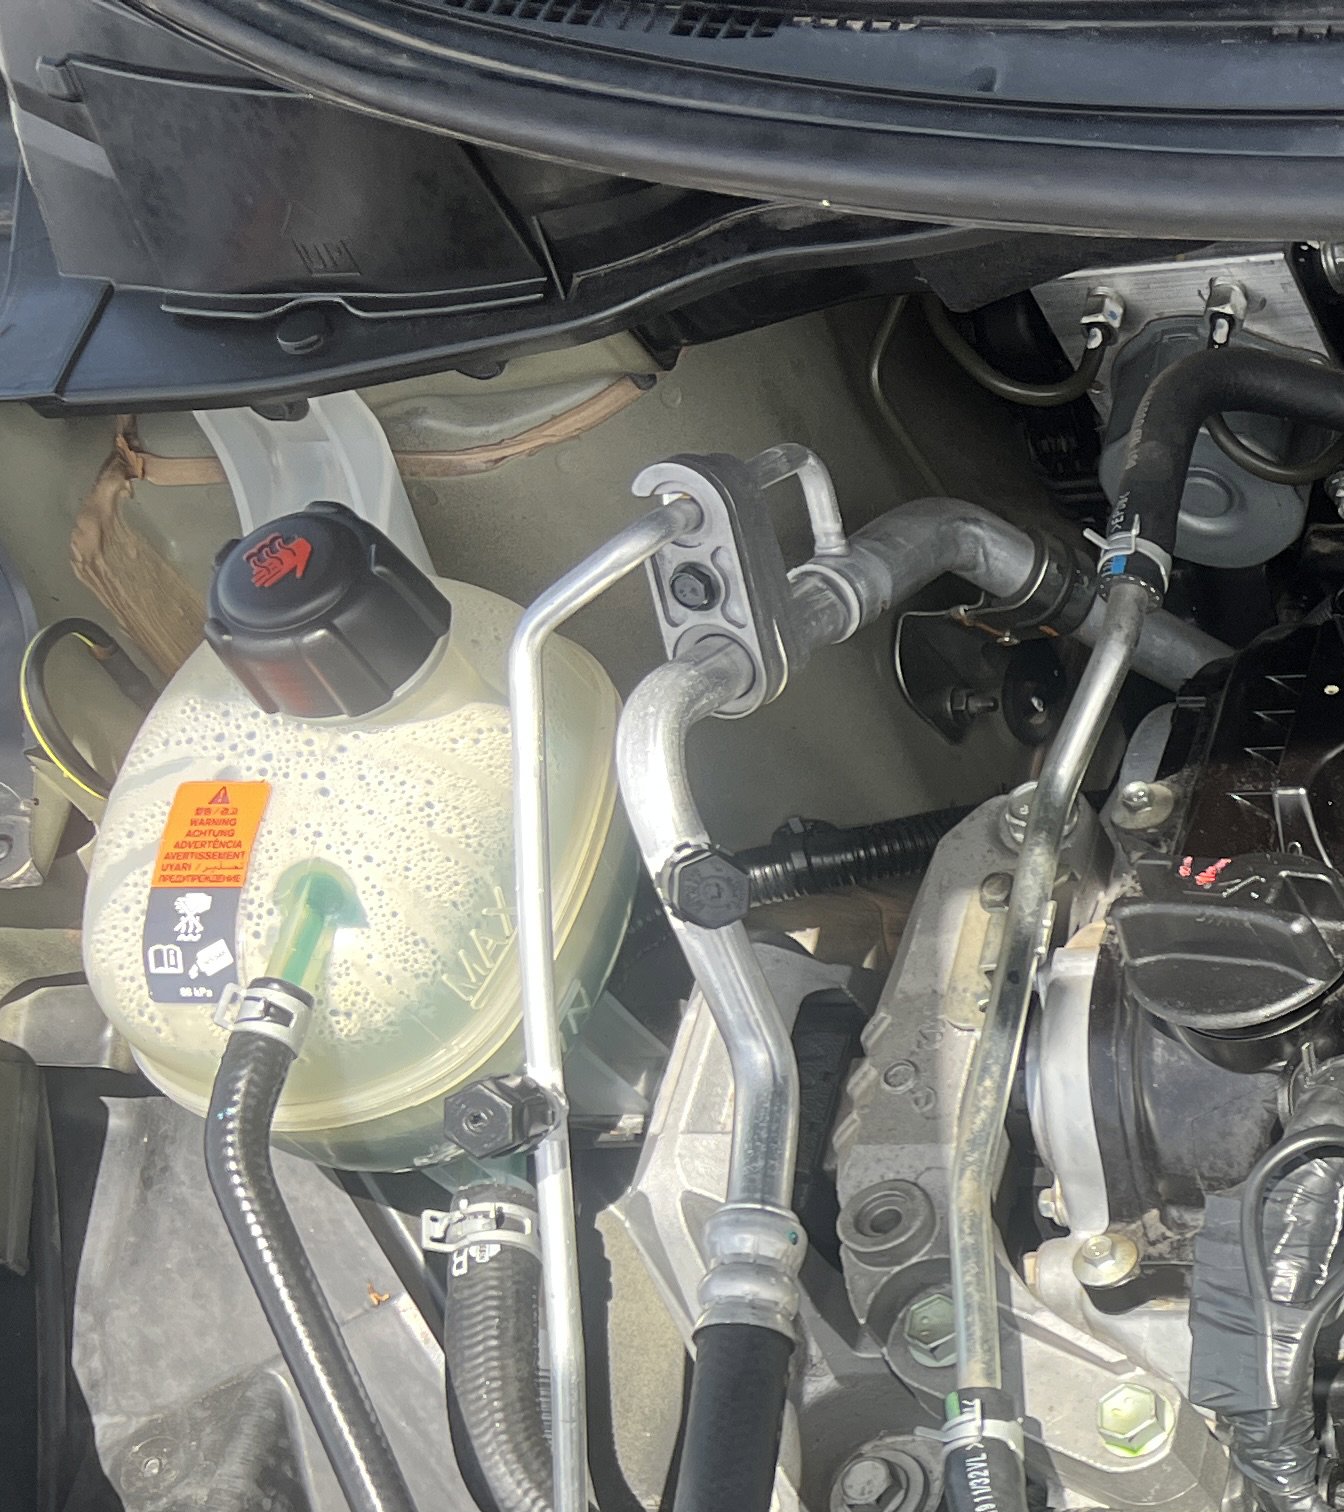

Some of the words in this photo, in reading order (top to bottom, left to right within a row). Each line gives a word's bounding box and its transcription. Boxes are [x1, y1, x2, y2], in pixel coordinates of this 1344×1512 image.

[190, 817, 238, 827] WARNING
[185, 829, 236, 838] ACHTUNG
[164, 850, 246, 860] AVERTISSEMENT
